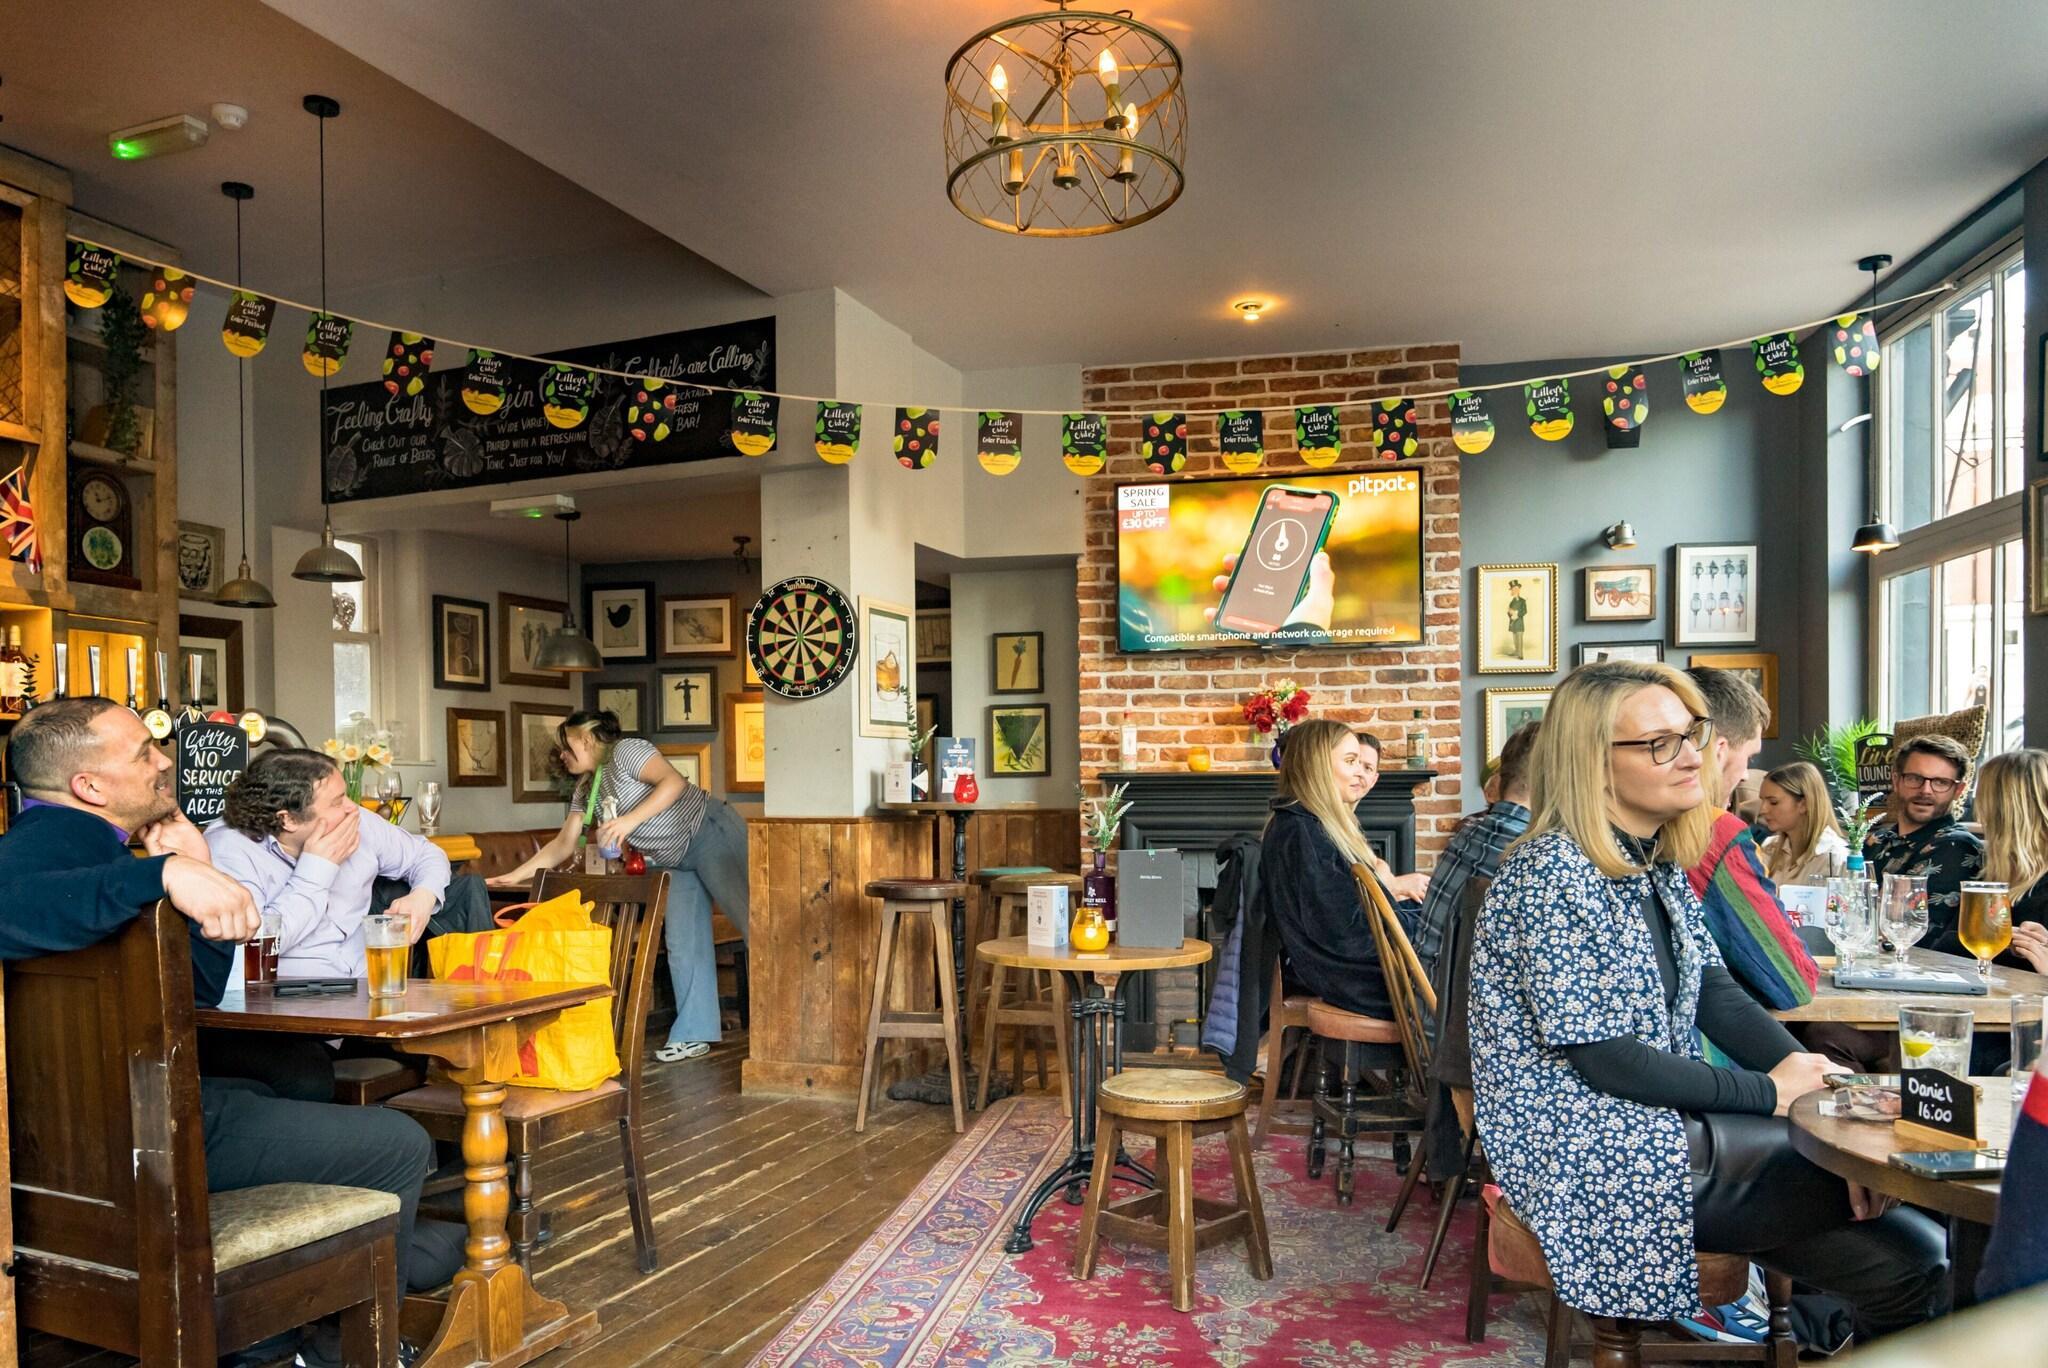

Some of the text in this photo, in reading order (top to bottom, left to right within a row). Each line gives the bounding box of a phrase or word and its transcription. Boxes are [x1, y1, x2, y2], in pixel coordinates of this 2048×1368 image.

[82, 251, 112, 266] Lilley's
[84, 263, 107, 274] Cider
[318, 320, 347, 334] Lilley's
[320, 332, 340, 342] Cider
[1760, 340, 1790, 354] Lilley's
[687, 360, 707, 374] are
[709, 344, 755, 373] Calling
[1766, 351, 1788, 361] Cider
[556, 373, 586, 384] Lilley's
[1532, 385, 1562, 398] Lilley's
[1538, 398, 1560, 407] Cider
[327, 390, 433, 444] Feeling Crafty
[824, 409, 854, 419] Lilley's
[1302, 413, 1332, 424] Lilley's
[675, 413, 701, 432] BAR!
[828, 420, 850, 428] Cider
[1070, 421, 1100, 432] Lilley's
[1308, 424, 1328, 432] Cider
[532, 438, 537, 446] A
[540, 431, 587, 446] REFRESHING
[1074, 432, 1096, 440] Cider
[1123, 488, 1164, 498] SPRING
[1130, 498, 1156, 507] SALE
[1143, 517, 1166, 528] OFF
[1144, 626, 1396, 644] Compatible smartphone and network coverage required
[185, 729, 239, 757] Sorry
[194, 751, 218, 768] NO
[1857, 747, 1896, 766] Live
[1859, 765, 1893, 782] LOUNG
[186, 798, 226, 815] AREA
[1908, 1077, 1952, 1103] Daniel
[1919, 1102, 1952, 1122] 16:00
